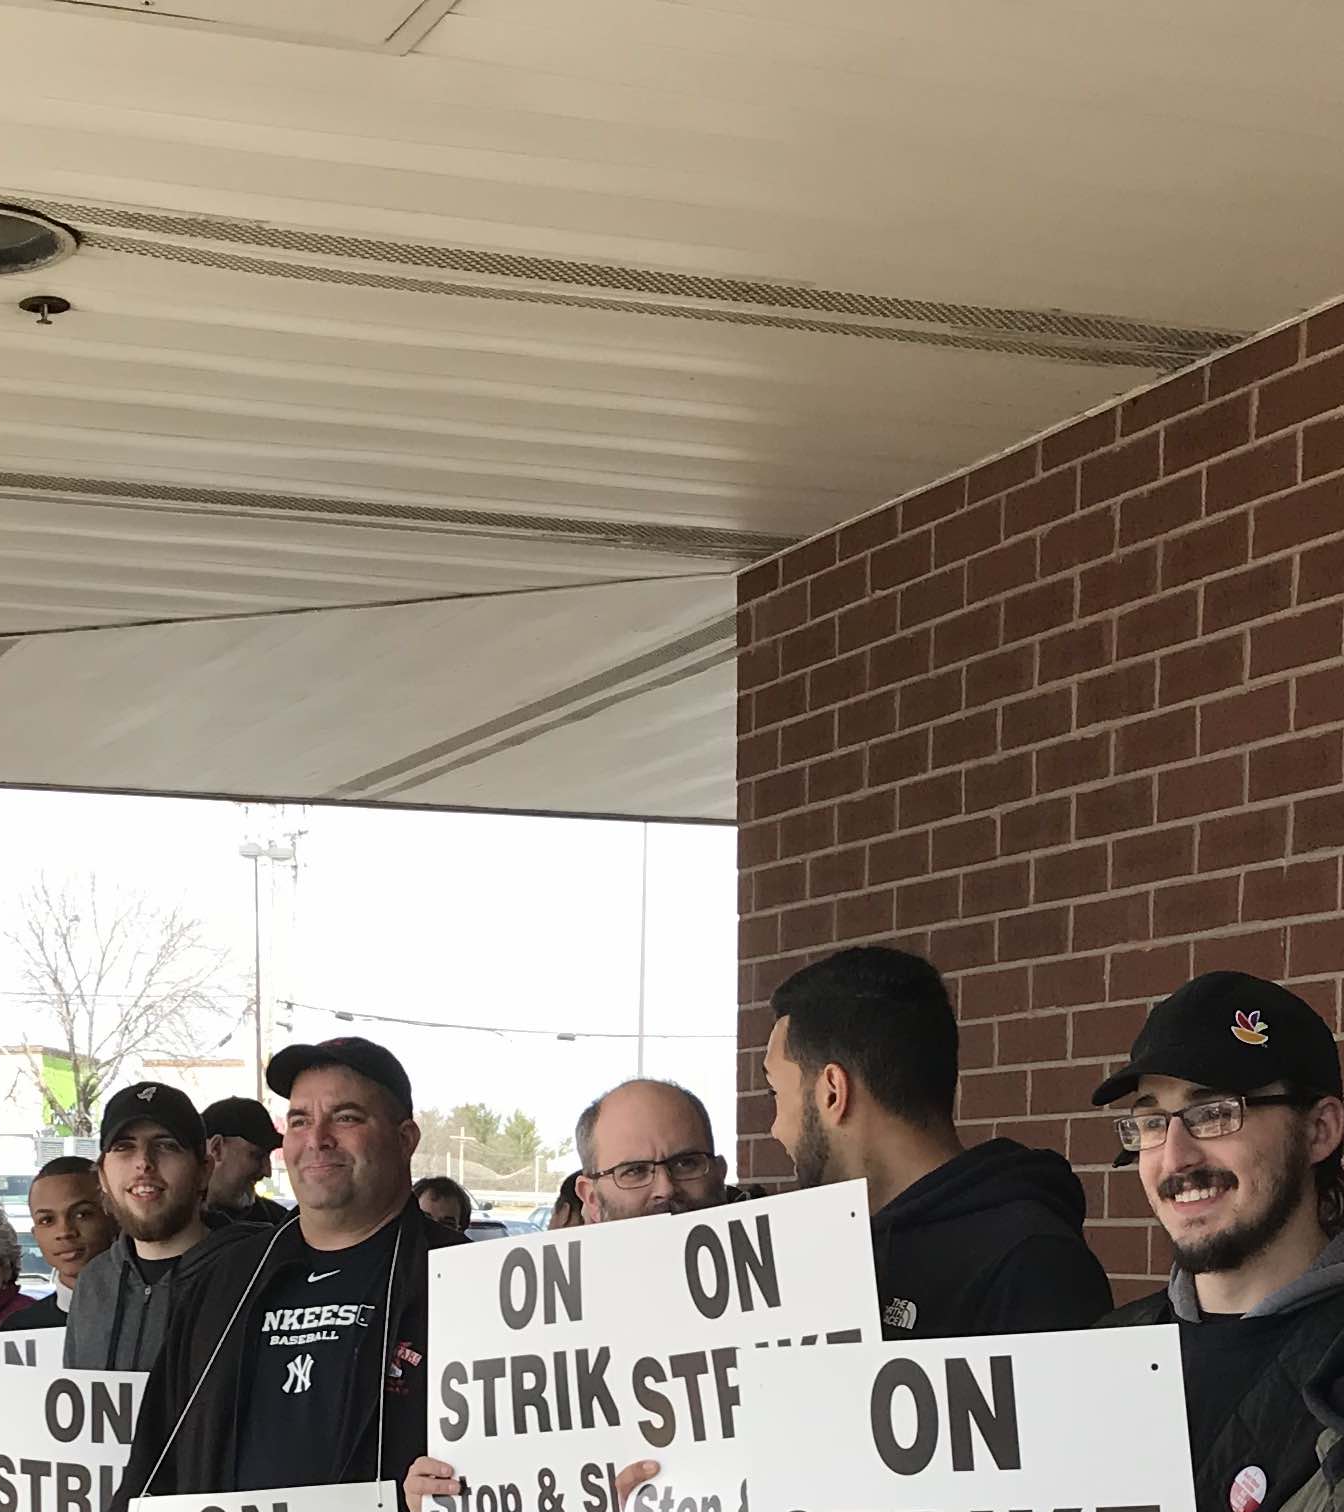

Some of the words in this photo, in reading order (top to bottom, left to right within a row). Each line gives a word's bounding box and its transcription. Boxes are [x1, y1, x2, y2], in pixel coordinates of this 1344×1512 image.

[500, 1241, 582, 1330] ON
[685, 1214, 781, 1319] ON
[261, 1304, 358, 1332] NKEES
[269, 1330, 339, 1346] BASEBALL
[45, 1378, 133, 1444] ON
[440, 1346, 620, 1442] STRIK
[871, 1355, 1021, 1475] ON
